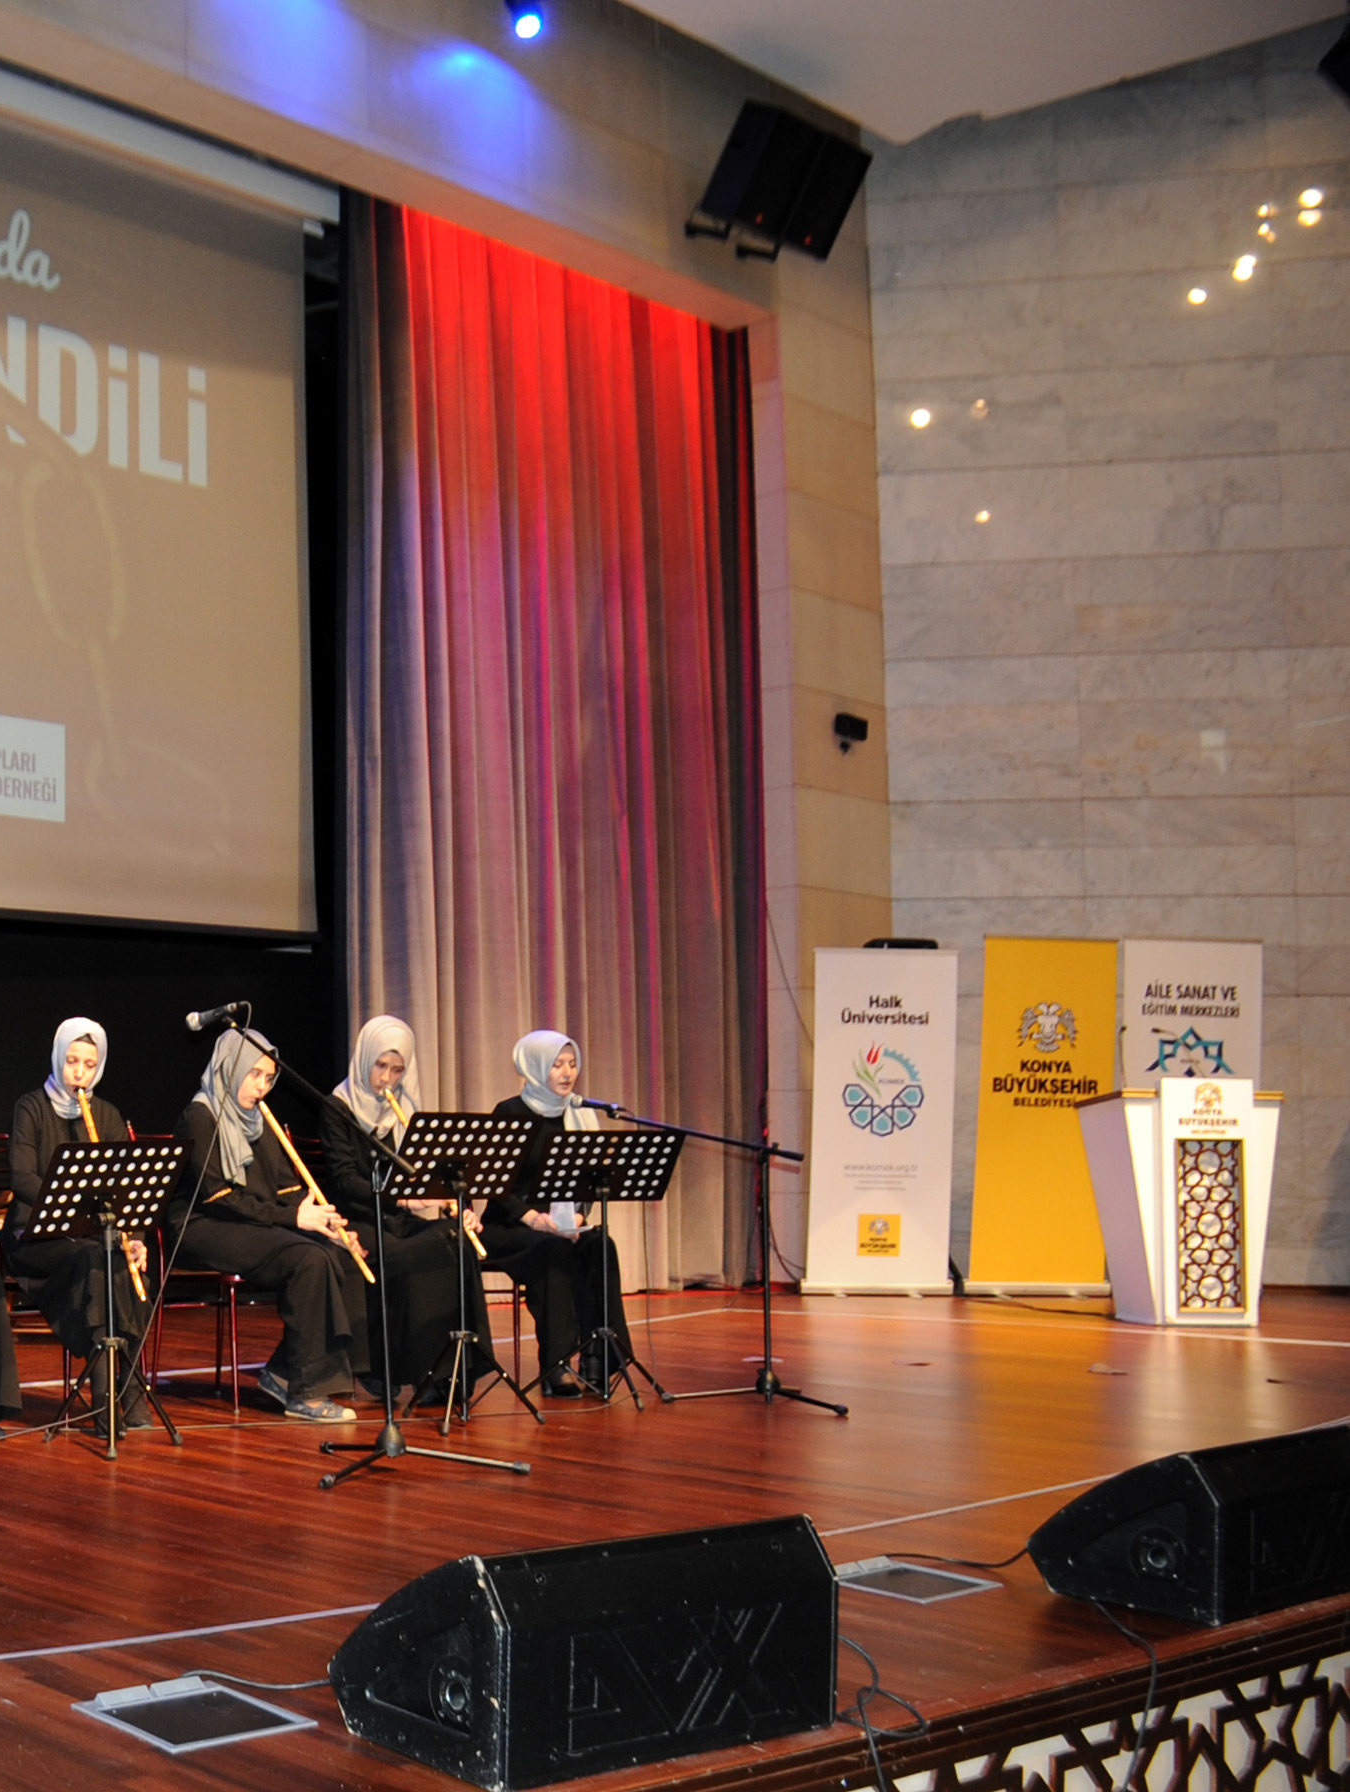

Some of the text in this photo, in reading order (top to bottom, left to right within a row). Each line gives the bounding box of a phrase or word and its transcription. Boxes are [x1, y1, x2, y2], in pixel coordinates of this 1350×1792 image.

[1145, 979, 1238, 1001] AİLE SANAT VE
[869, 994, 903, 1009] Halk
[841, 1007, 929, 1025] Üniversitesi
[1180, 1003, 1240, 1018] MERKEZLERİ
[1019, 1059, 1072, 1074] KONYA
[992, 1073, 1099, 1095] BÜYÜKŞEHİR
